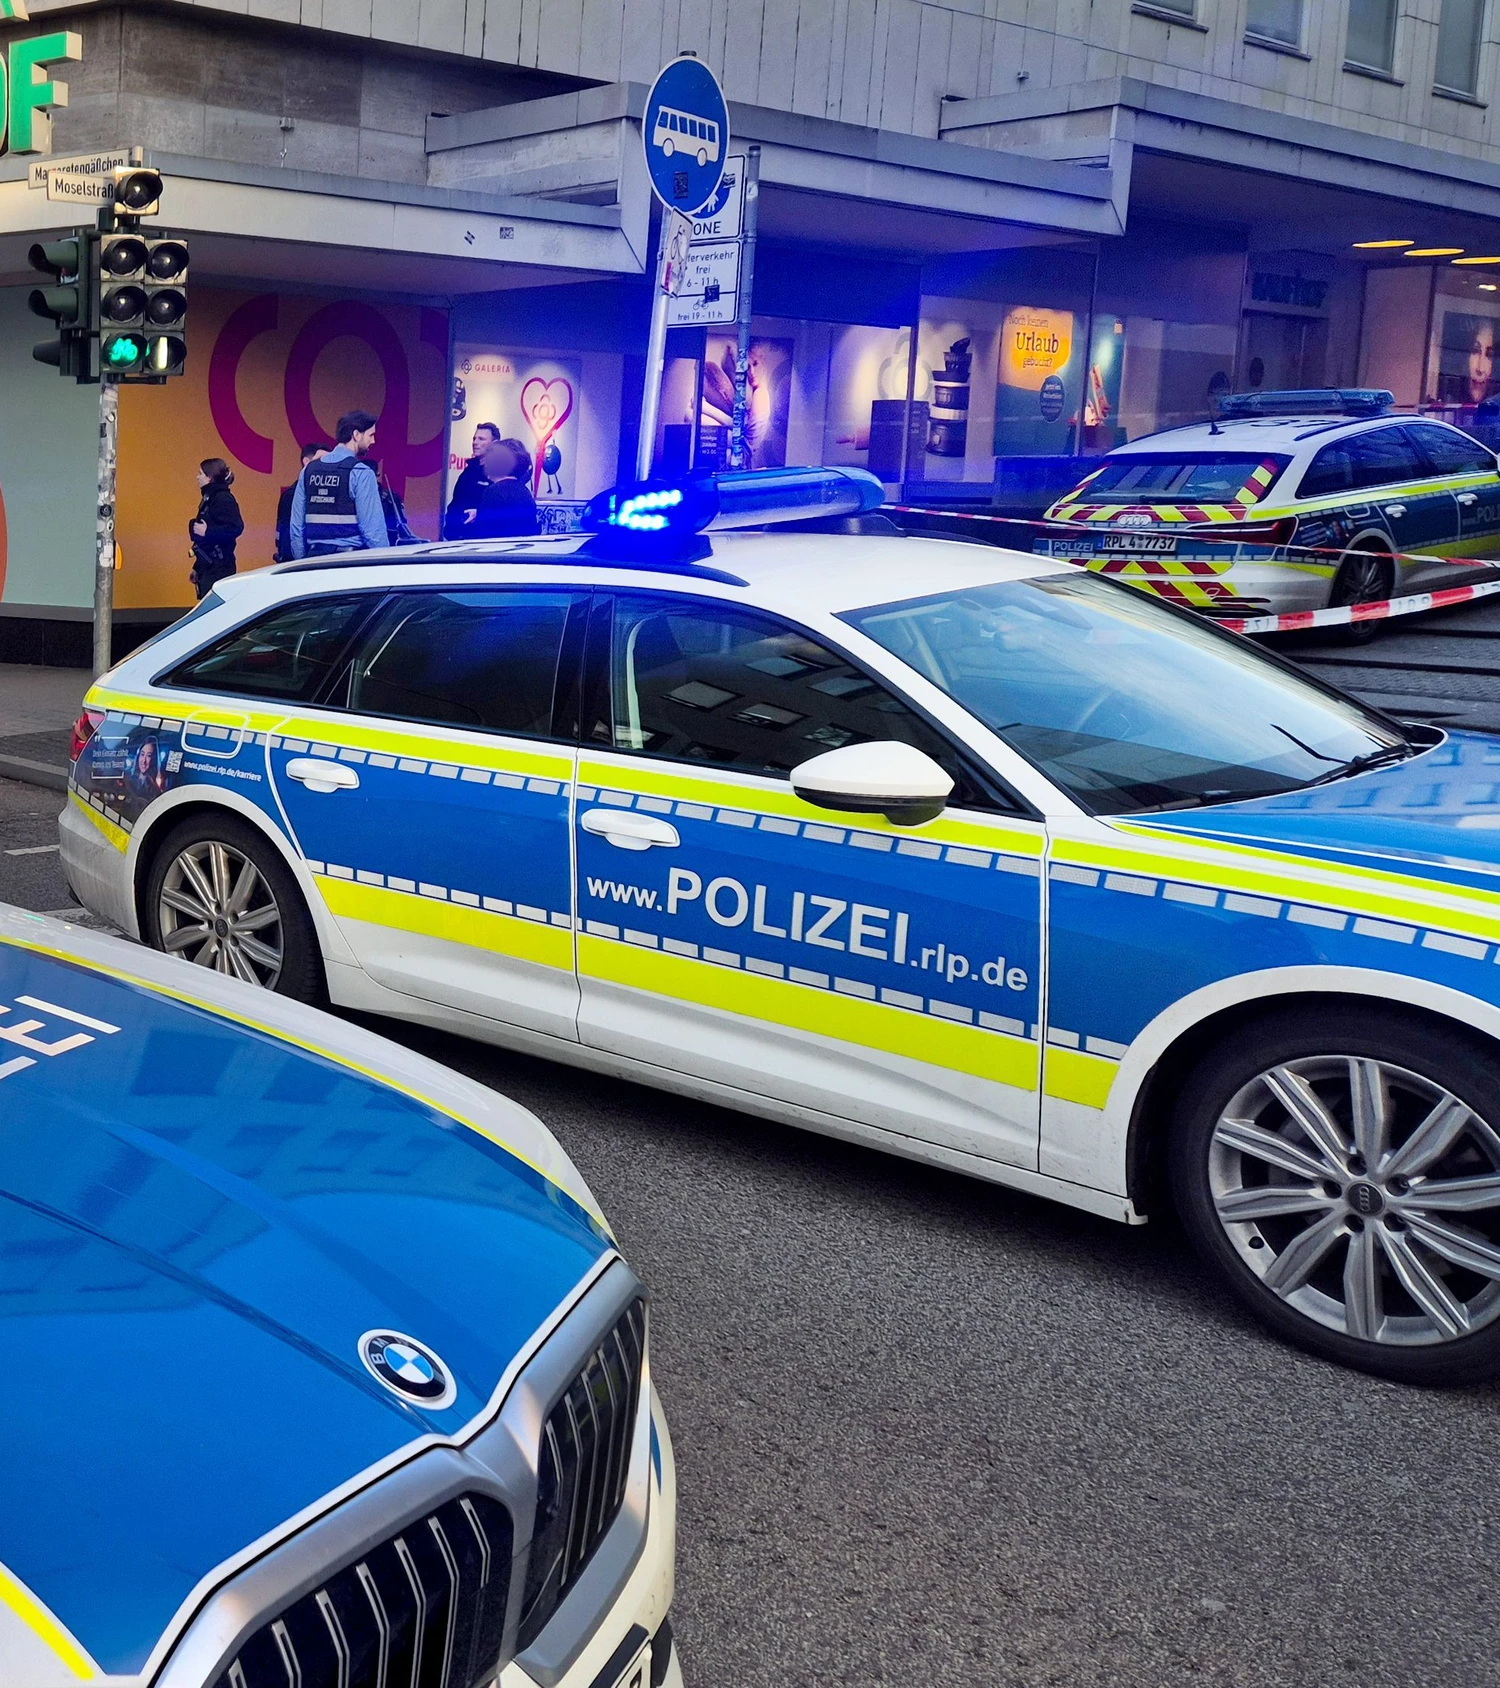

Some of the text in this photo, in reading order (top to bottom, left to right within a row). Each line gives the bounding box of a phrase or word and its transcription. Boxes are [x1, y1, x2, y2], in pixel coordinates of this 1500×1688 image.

[55, 178, 114, 199] Moselstraß
[693, 221, 722, 235] ONE
[687, 251, 735, 263] ferverkehr
[696, 263, 711, 274] frei
[1016, 331, 1059, 353] Urlaub
[475, 364, 511, 373] GALERIA
[309, 474, 340, 487] POLIZEI
[1053, 541, 1093, 551] POLIZEI
[1103, 535, 1175, 549] RPL 4 7737
[587, 867, 1029, 992] www.POLIZEI.rlp.de
